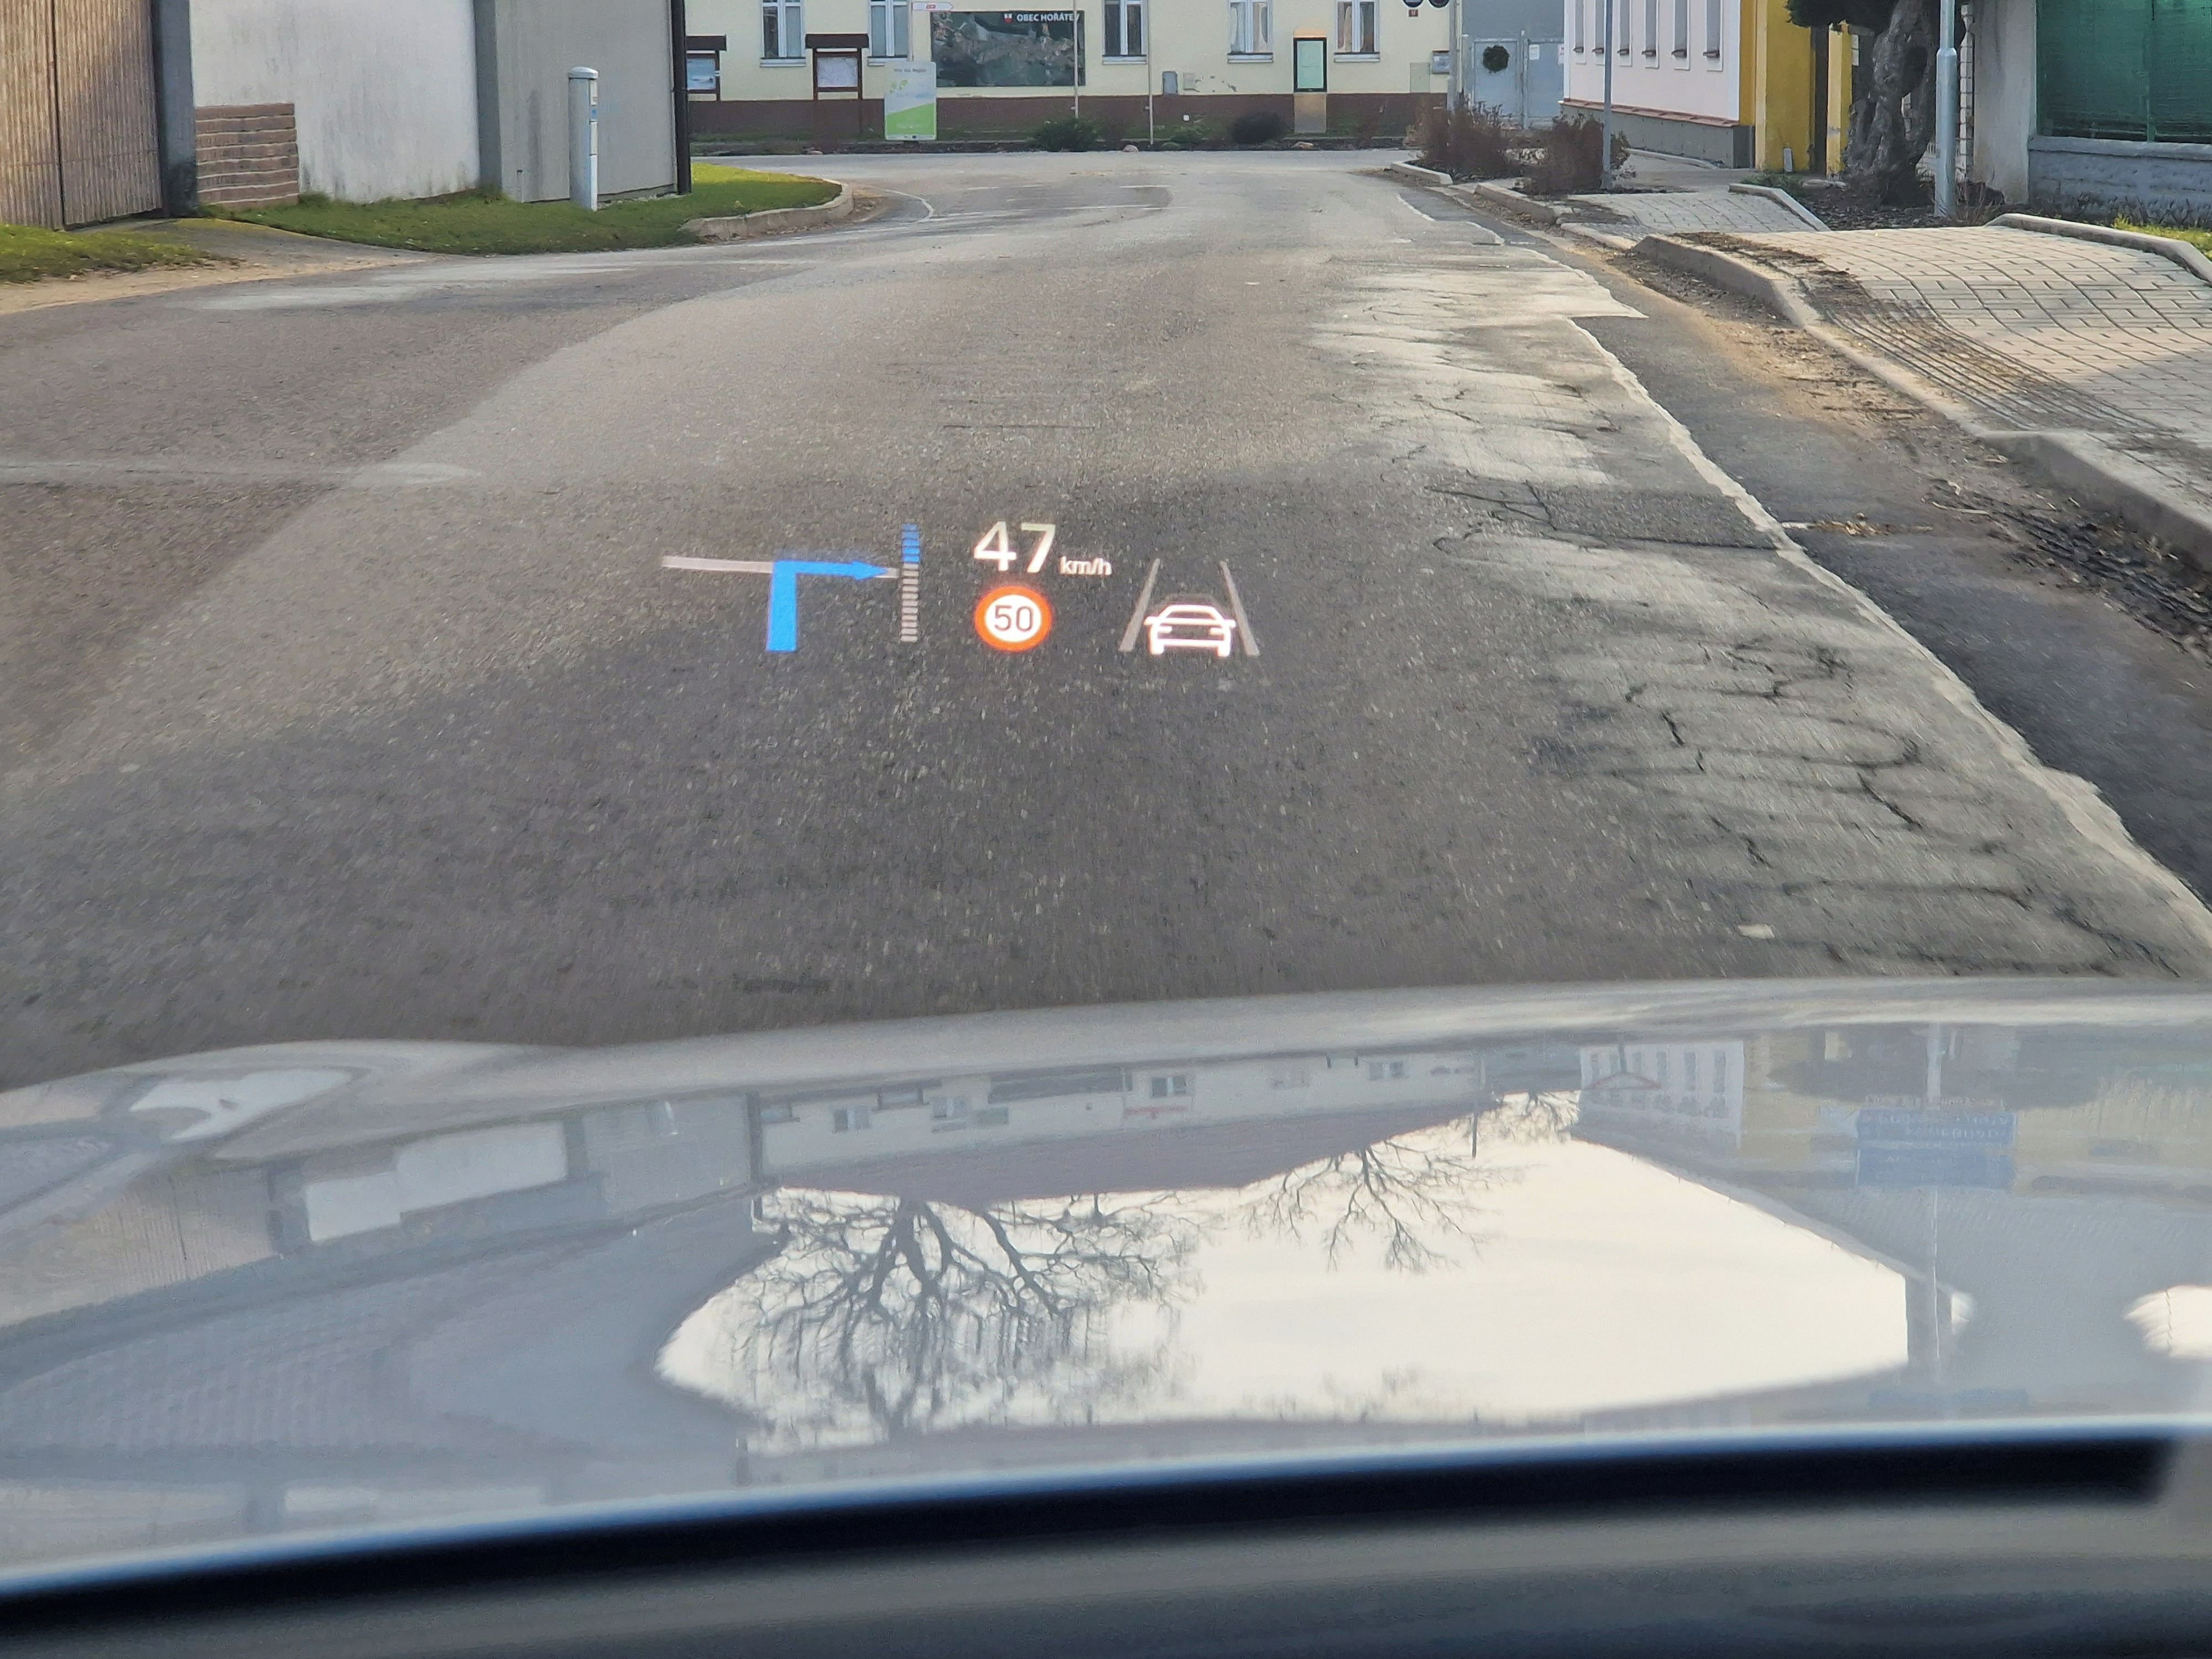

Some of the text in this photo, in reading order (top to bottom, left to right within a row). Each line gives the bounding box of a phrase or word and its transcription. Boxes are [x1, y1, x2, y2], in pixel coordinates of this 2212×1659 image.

[1016, 13, 1039, 22] OBEC
[973, 521, 1112, 575] 47 km/h
[994, 604, 1033, 632] 50
